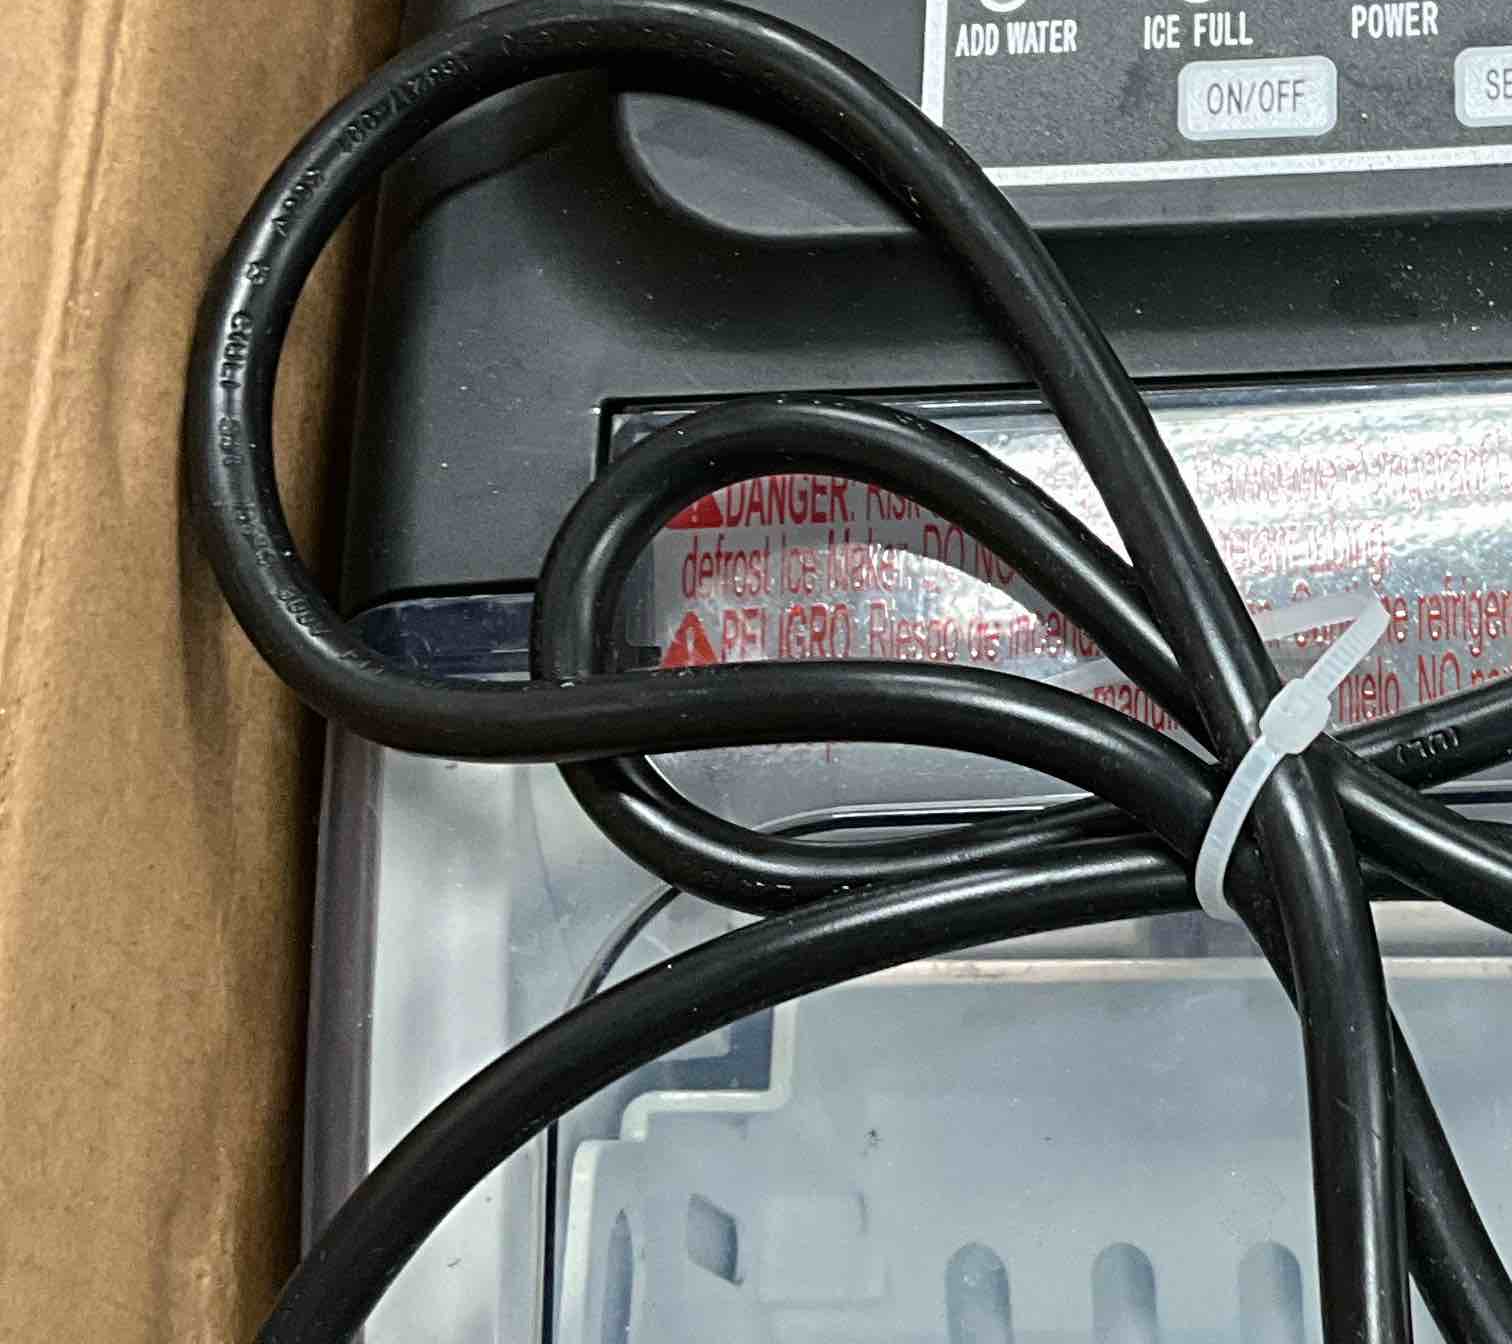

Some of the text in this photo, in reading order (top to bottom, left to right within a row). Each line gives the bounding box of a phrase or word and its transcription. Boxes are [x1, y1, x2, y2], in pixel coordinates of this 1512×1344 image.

[955, 19, 1077, 57] ADD WATER
[1143, 11, 1253, 50] ICE FULL
[1351, 1, 1438, 39] POWER
[1207, 80, 1304, 114] ON/OFF
[682, 532, 771, 599] defrost
[781, 535, 818, 596] Ice
[1418, 649, 1461, 704] NO
